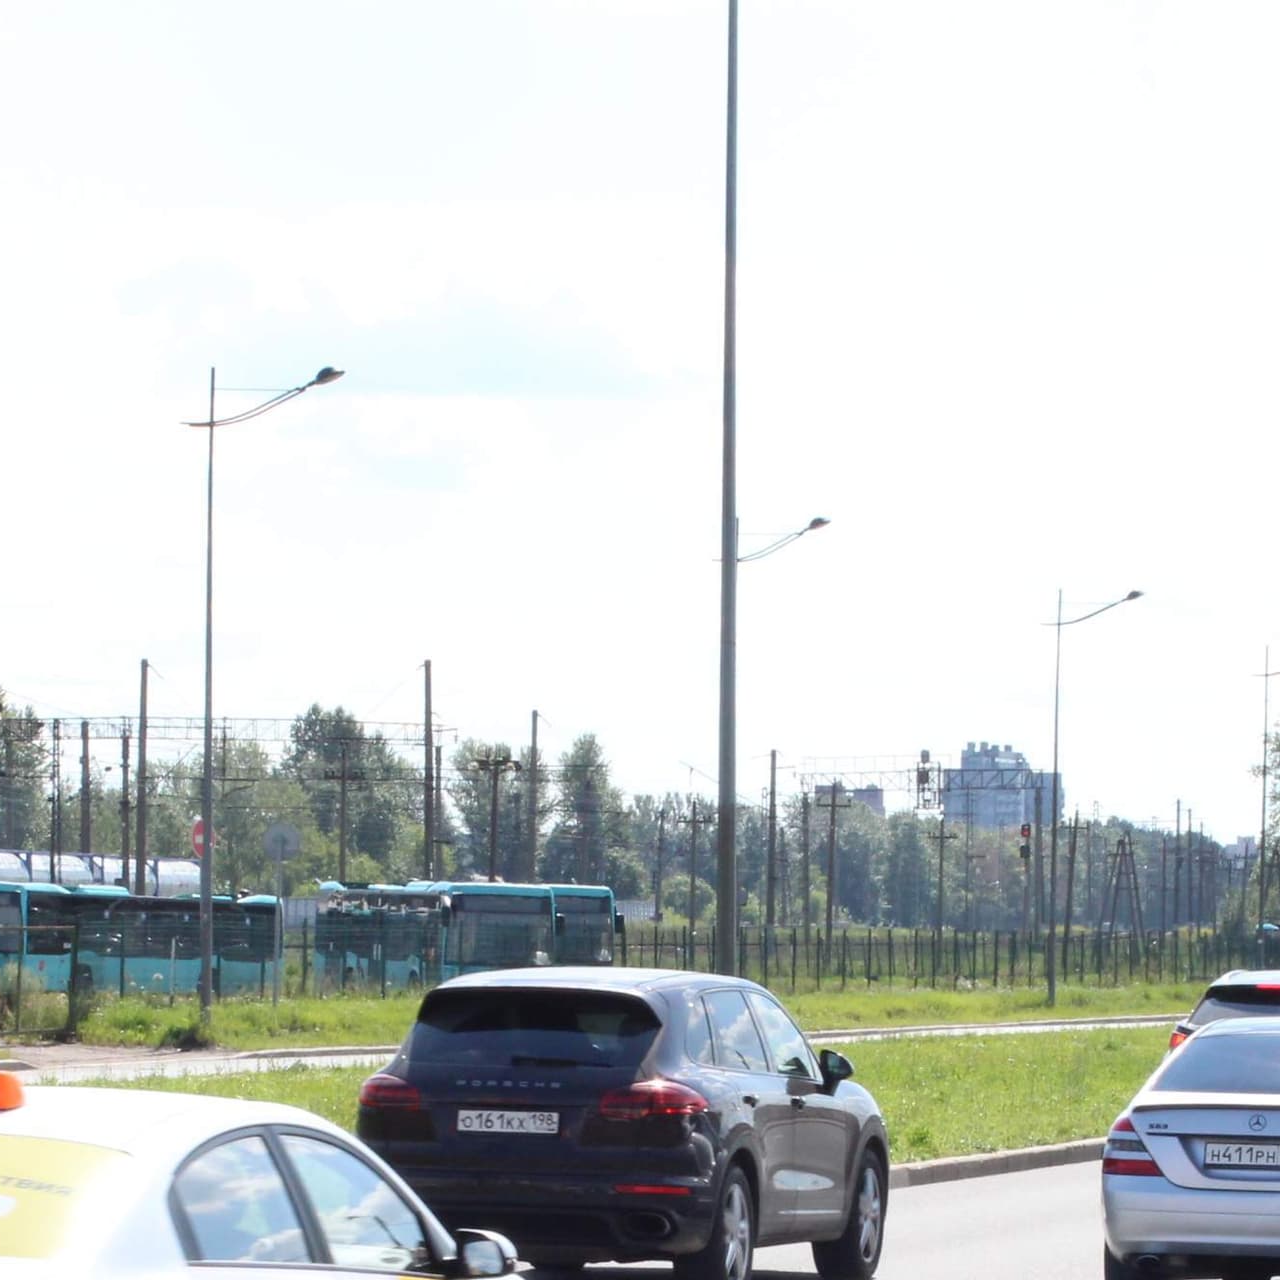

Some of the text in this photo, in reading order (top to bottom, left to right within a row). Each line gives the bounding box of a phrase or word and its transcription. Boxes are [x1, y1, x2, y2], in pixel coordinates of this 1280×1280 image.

[462, 1113, 554, 1129] О161КХ 198
[1211, 1145, 1276, 1164] Н411РН
